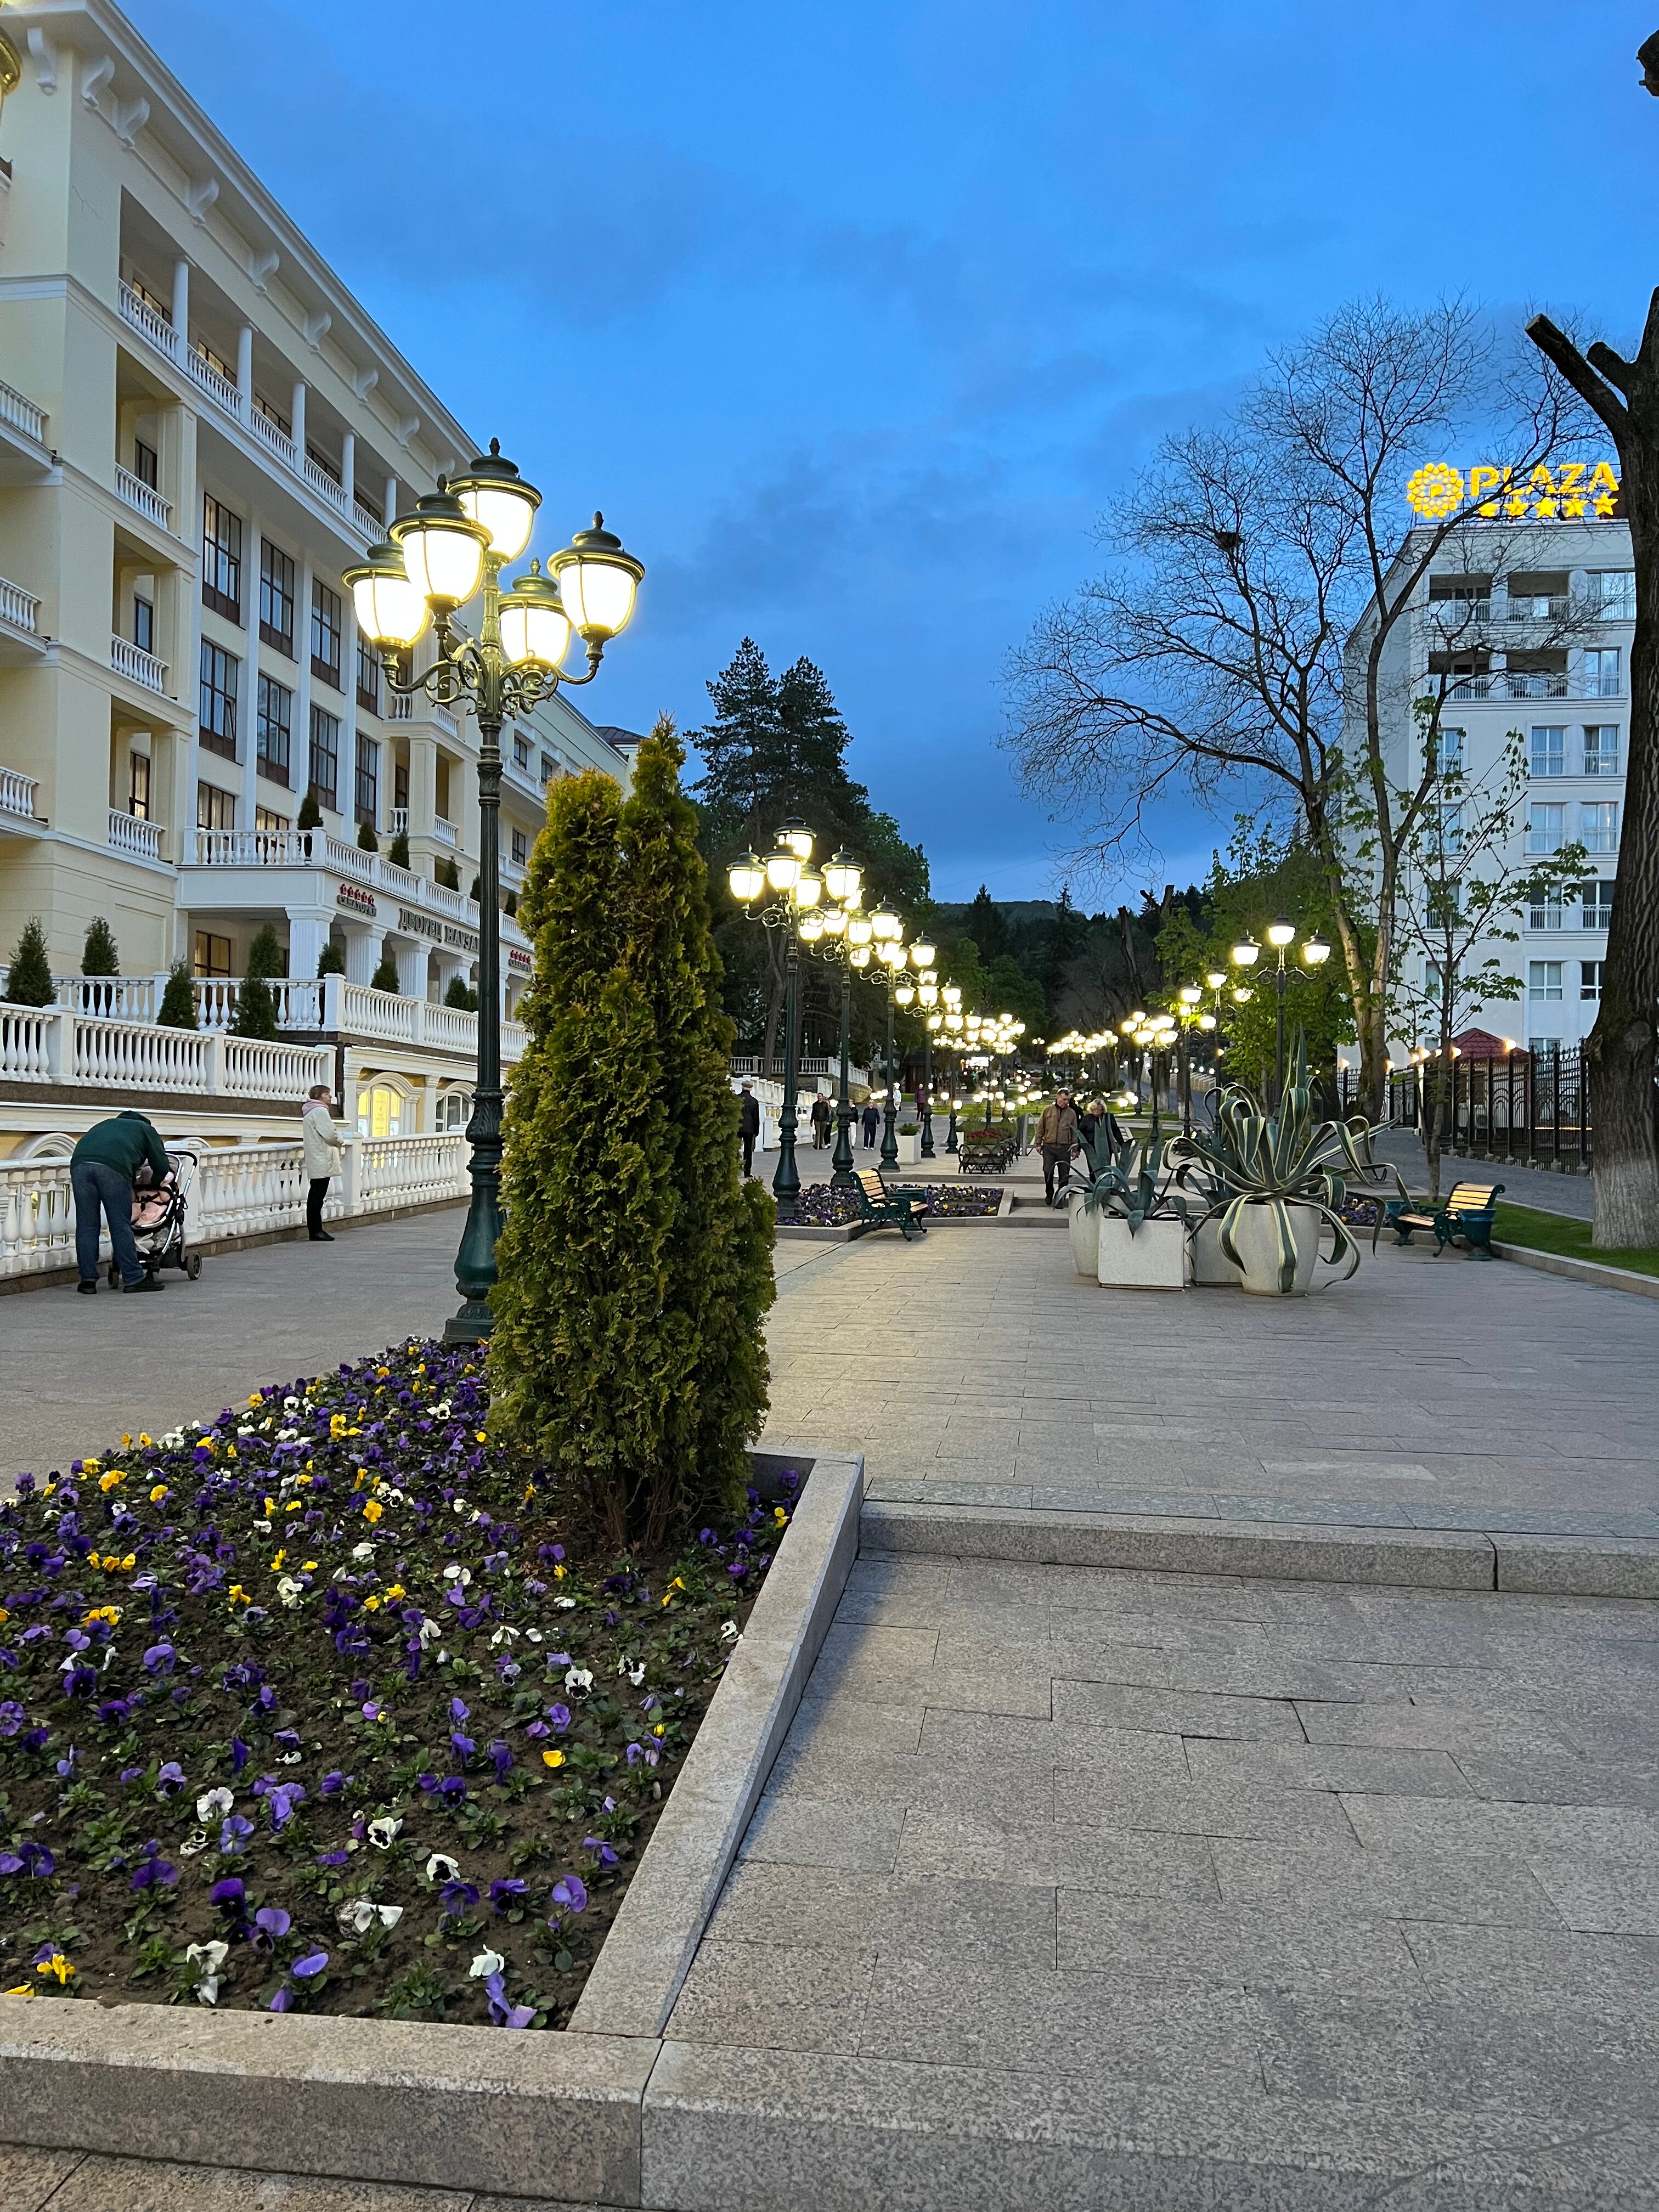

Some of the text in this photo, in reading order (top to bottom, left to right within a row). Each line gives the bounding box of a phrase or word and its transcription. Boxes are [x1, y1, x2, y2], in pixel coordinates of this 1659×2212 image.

[1470, 462, 1619, 496] PLAZA
[399, 908, 479, 953] ДВОРЕЦ НАРЗА
